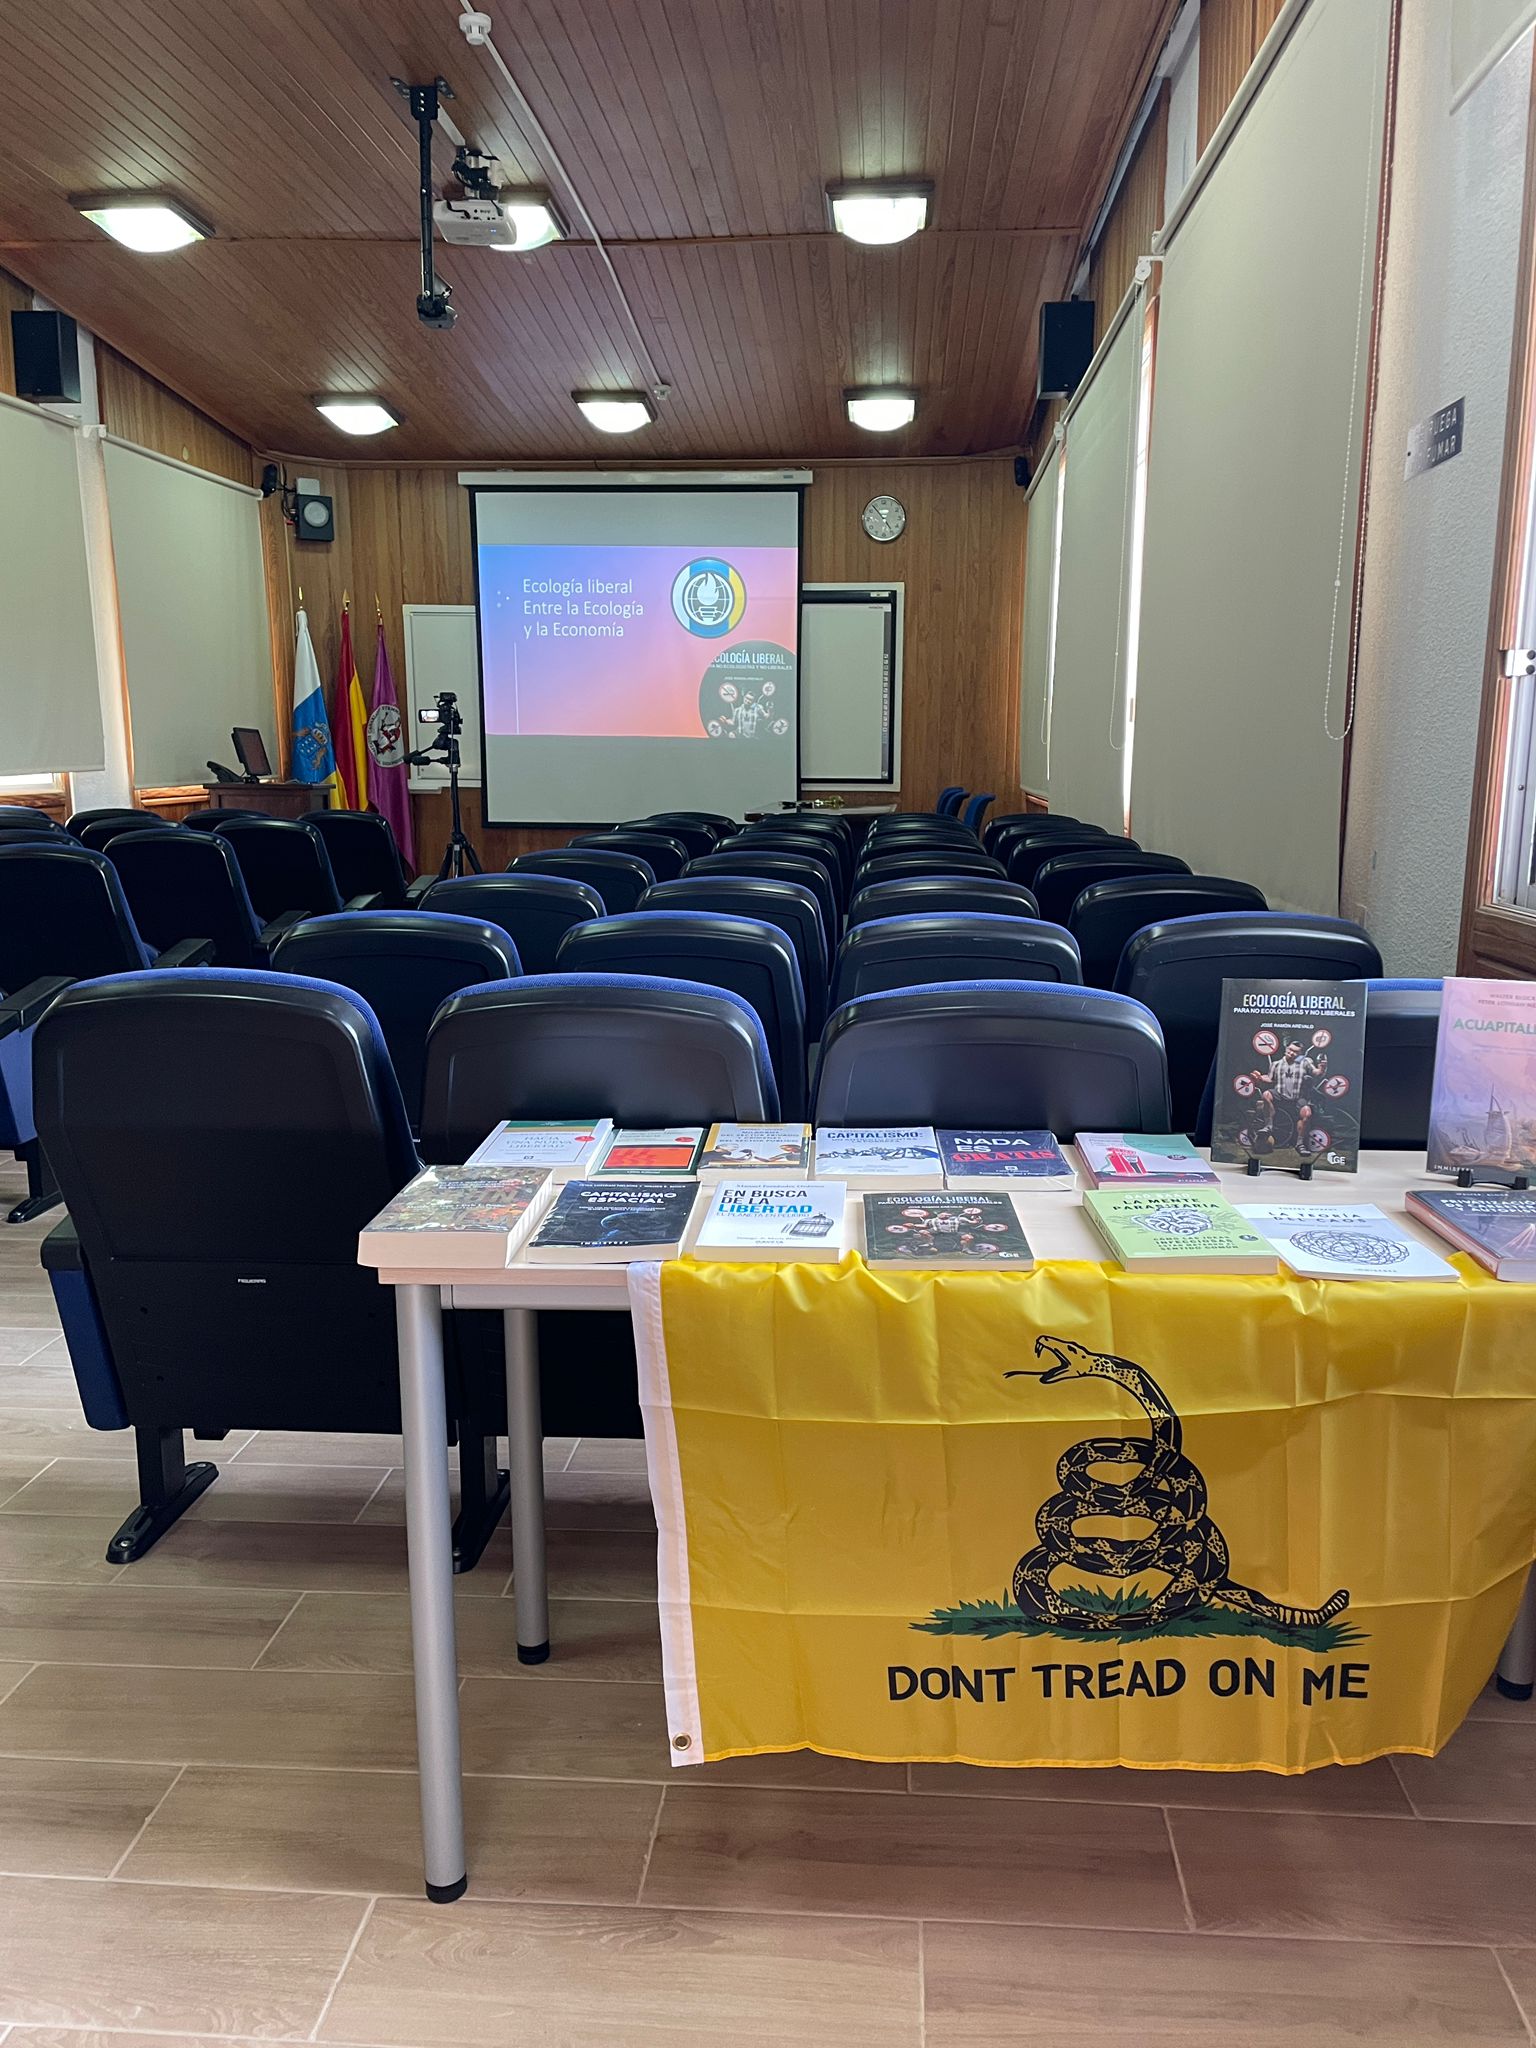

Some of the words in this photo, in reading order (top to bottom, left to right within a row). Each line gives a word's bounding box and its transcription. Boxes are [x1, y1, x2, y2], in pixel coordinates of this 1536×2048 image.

[523, 578, 583, 597] Ecología
[587, 579, 633, 594] liberal
[524, 600, 562, 615] Entre
[567, 600, 579, 615] la
[584, 601, 644, 618] Ecología
[523, 625, 532, 640] y
[536, 621, 548, 636] la
[553, 622, 624, 637] Economía
[752, 653, 786, 665] LIBERAL
[1243, 991, 1297, 1008] ECOLOGÍA
[1300, 996, 1346, 1010] LIBERAL
[953, 1137, 1031, 1146] NADA
[956, 1145, 992, 1153] ES
[952, 1150, 1057, 1162] GRATIS
[723, 1189, 746, 1198] EN
[751, 1190, 808, 1198] BUSCA
[720, 1196, 743, 1204] DE
[748, 1197, 770, 1205] LA
[718, 1204, 813, 1214] LIBERTAD
[887, 1665, 1016, 1703] DONT
[1031, 1658, 1186, 1700] TREAD
[1208, 1657, 1275, 1698] ON
[1302, 1663, 1370, 1706] ME
